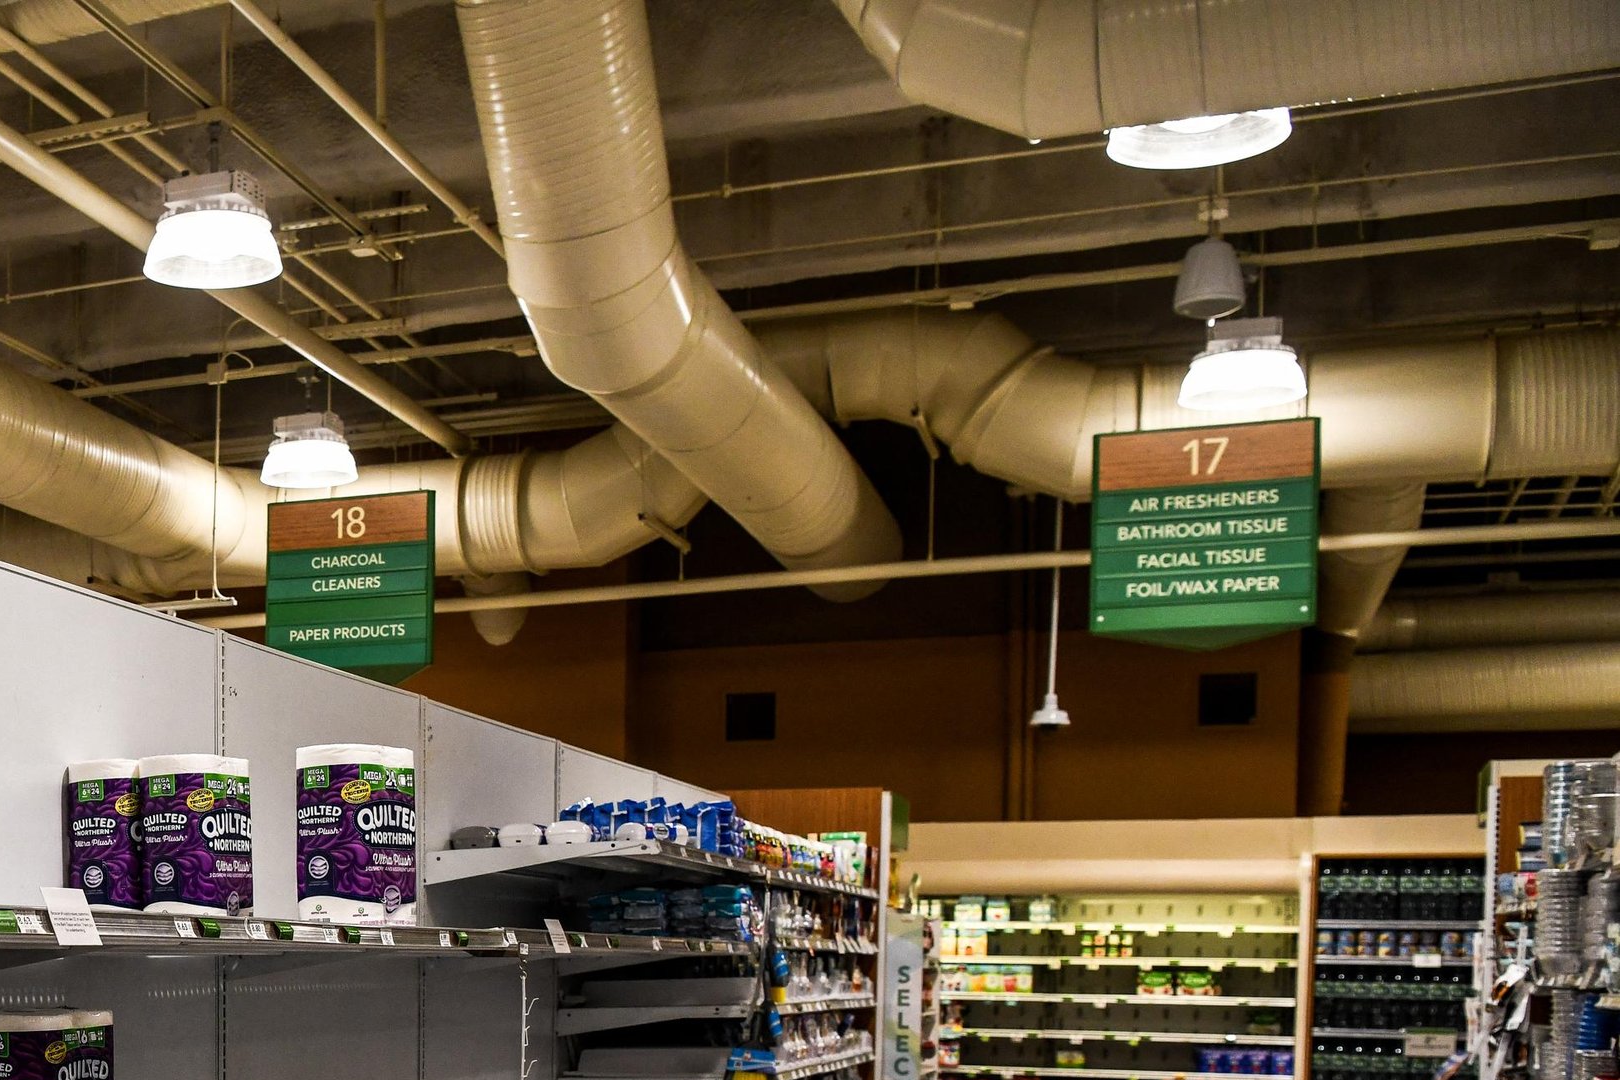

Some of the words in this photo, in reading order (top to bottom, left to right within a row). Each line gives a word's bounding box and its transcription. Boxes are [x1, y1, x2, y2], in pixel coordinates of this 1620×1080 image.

[1182, 437, 1229, 476] 17
[1129, 497, 1159, 513] AIR
[1163, 489, 1280, 511] FRESHENERS
[331, 507, 366, 539] 18
[1117, 521, 1221, 541] BATHROOM
[1227, 517, 1288, 535] TISSUE
[311, 553, 386, 569] CHARCOAL
[1137, 552, 1200, 569] FACIAL
[1205, 548, 1267, 566] TISSUE
[312, 576, 381, 592] CLEANERS
[1126, 579, 1219, 598] FOIL/WAX
[1222, 576, 1280, 593] PAPER
[289, 628, 330, 642] PAPER
[333, 624, 406, 639] PRODUCTS
[363, 771, 382, 781] MEGA
[208, 780, 225, 790] MEGA
[226, 779, 237, 795] 24
[143, 813, 187, 827] QUILTED
[298, 806, 342, 820] QUILTED
[357, 804, 416, 832] QUILTED
[72, 817, 117, 832] QUILTED
[147, 824, 181, 832] NORTHERN
[202, 812, 252, 839] QUILTED
[301, 817, 335, 825] NORTHERN
[76, 828, 110, 836] NORTHERN
[145, 836, 161, 844] Ultra
[162, 834, 185, 842] Plush
[299, 829, 316, 837] Ultra
[317, 827, 339, 836] Plush
[371, 831, 412, 845] NORTHERN
[74, 840, 91, 848] Ultra
[91, 838, 113, 846] Plush
[214, 838, 250, 852] NORTHERN
[373, 853, 393, 865] Ultra
[393, 854, 412, 866] Plush
